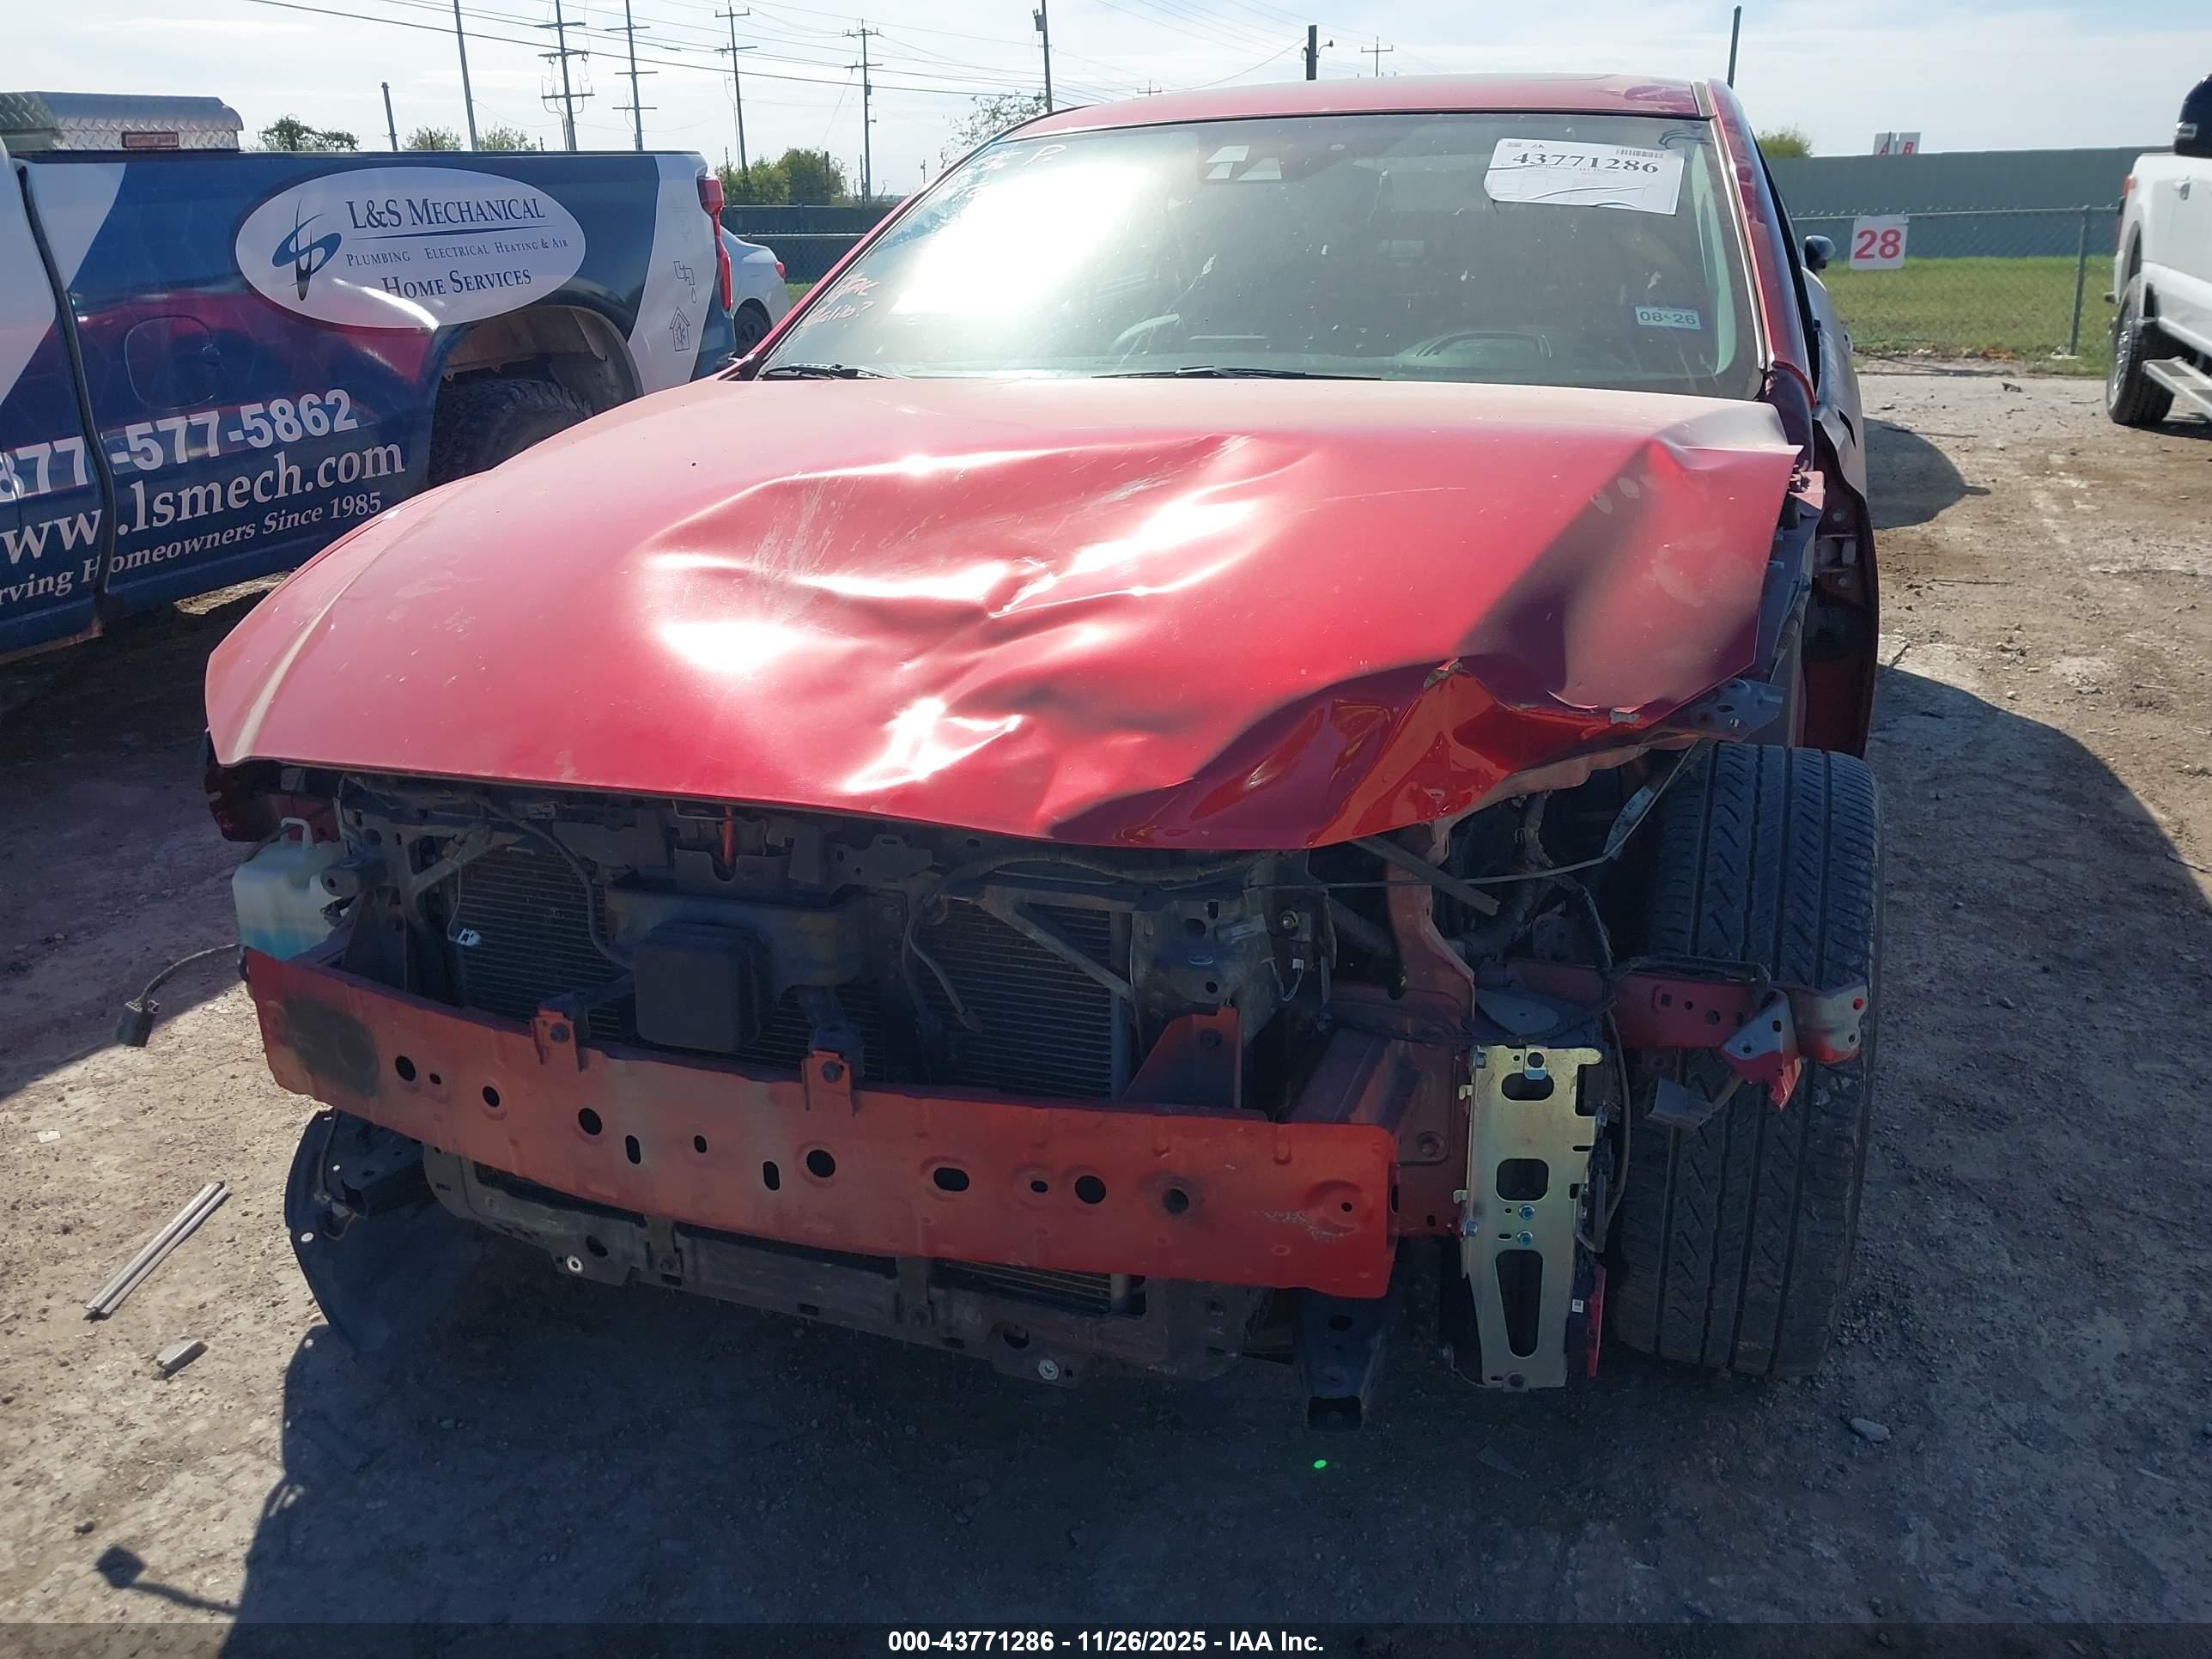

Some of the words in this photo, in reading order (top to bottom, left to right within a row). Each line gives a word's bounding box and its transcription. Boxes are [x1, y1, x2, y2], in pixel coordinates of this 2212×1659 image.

[1512, 151, 1659, 173] 43771286
[345, 198, 402, 229] L&S
[405, 198, 546, 226] MECHANICAL
[346, 250, 411, 266] PLUMBING
[424, 244, 490, 259] ELECTRICAL
[495, 237, 538, 253] HEATING
[540, 238, 550, 249] &
[552, 237, 569, 248] AIR
[1854, 228, 1902, 259] 28
[380, 275, 447, 300] HOME
[449, 269, 532, 294] SERVICES
[262, 502, 324, 534] Since
[329, 490, 382, 520] 1985
